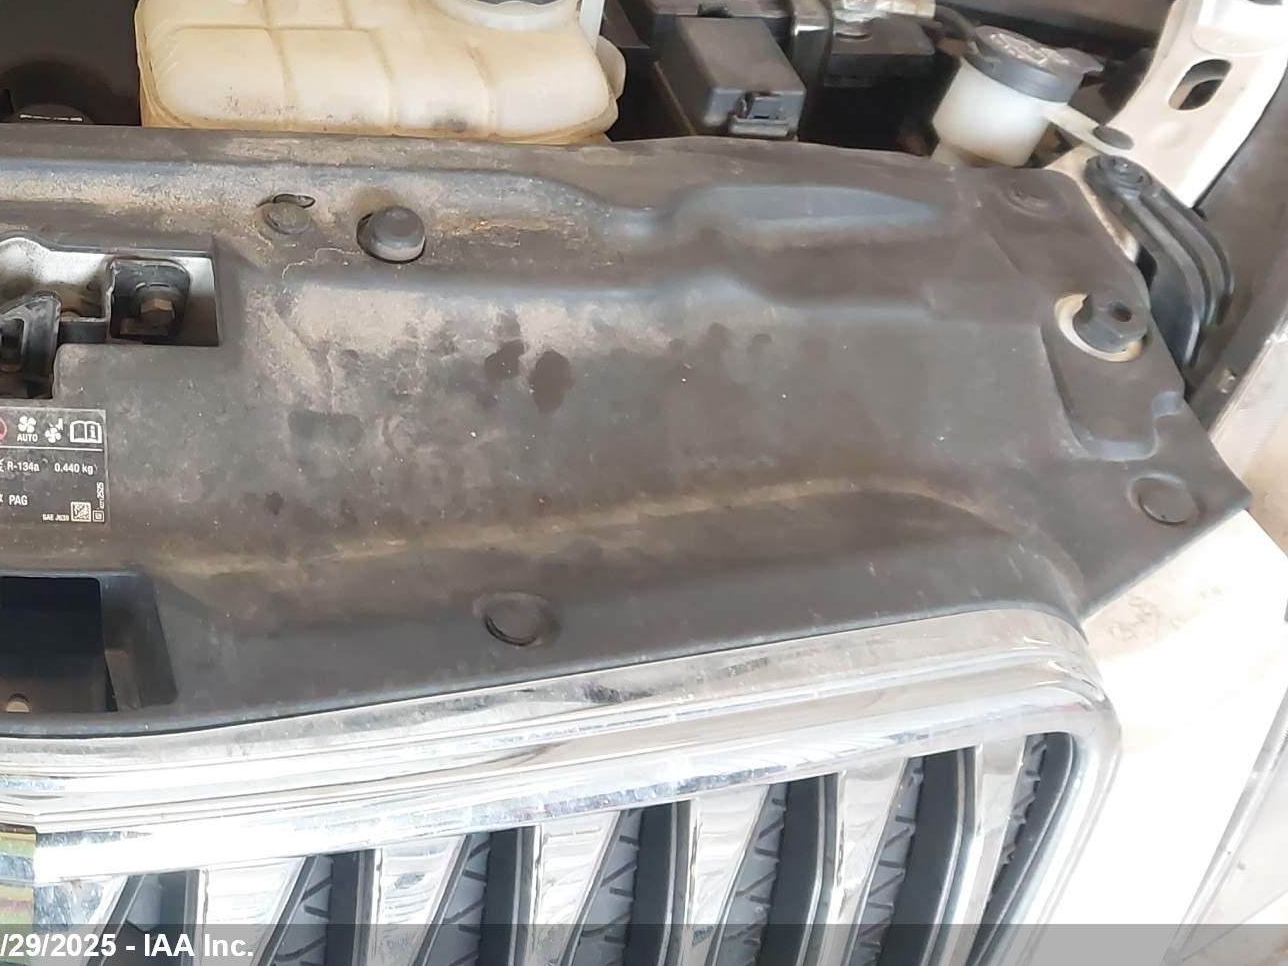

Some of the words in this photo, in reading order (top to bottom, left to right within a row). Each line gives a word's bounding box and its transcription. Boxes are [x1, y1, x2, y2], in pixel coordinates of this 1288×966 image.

[16, 434, 38, 443] AUTO
[7, 461, 40, 472] R-134a
[54, 462, 80, 473] 0.440
[81, 463, 94, 476] kg
[8, 494, 28, 506] PAG
